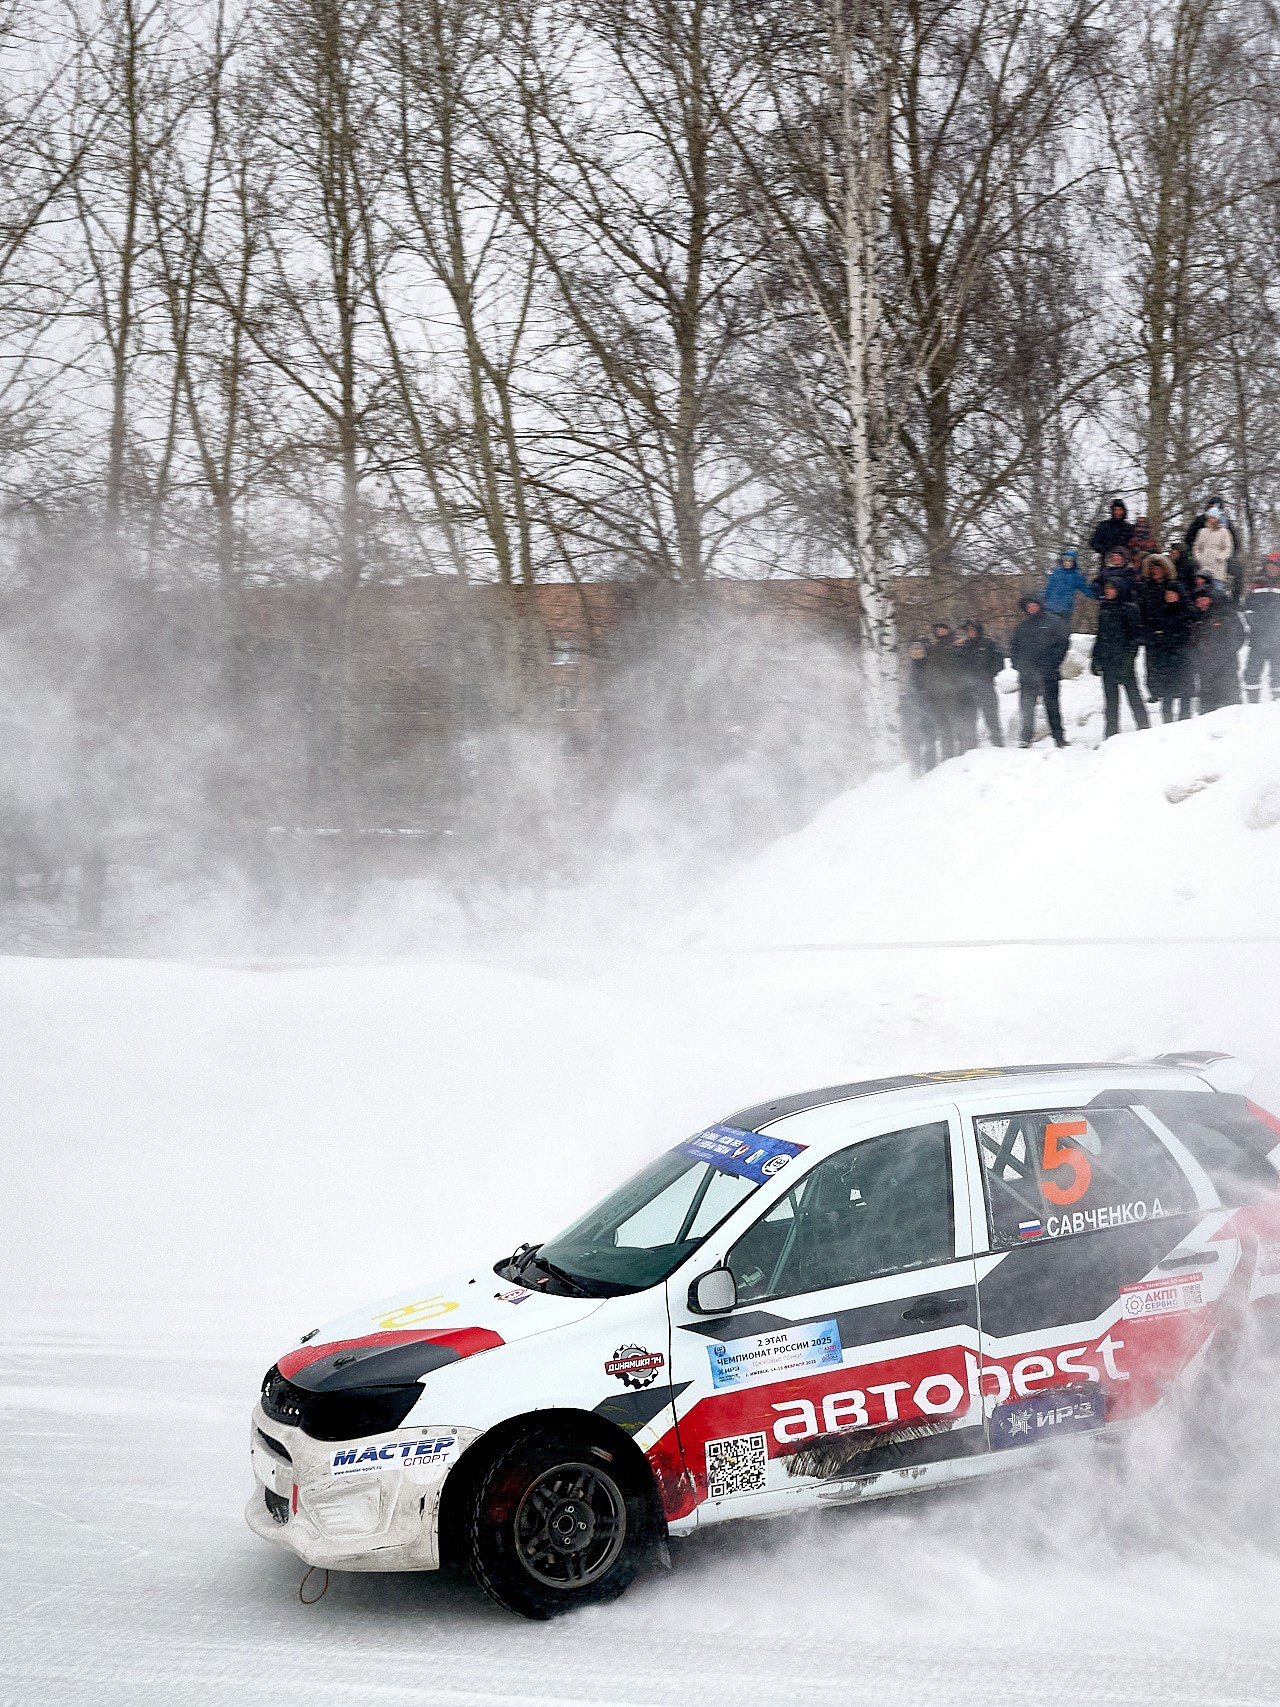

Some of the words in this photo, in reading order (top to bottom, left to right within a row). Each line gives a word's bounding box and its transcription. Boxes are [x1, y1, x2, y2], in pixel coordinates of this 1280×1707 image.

[1040, 1121, 1091, 1205] 5
[1046, 1201, 1147, 1236] САВЧЕНКО
[1145, 1289, 1178, 1303] АКПП
[1145, 1299, 1179, 1310] СЕРВИС
[757, 1339, 763, 1347] 2
[765, 1334, 787, 1346] ЭТАП
[717, 1348, 771, 1366] ЧЕМПИОНАТ
[774, 1342, 809, 1354] РОССИИ
[811, 1336, 832, 1347] 2025
[607, 1357, 650, 1372] ДИНАМИКА
[1036, 1402, 1096, 1426] ИРЗ
[333, 1436, 455, 1467] МАСТЕР
[403, 1453, 450, 1467] СПОРТ
